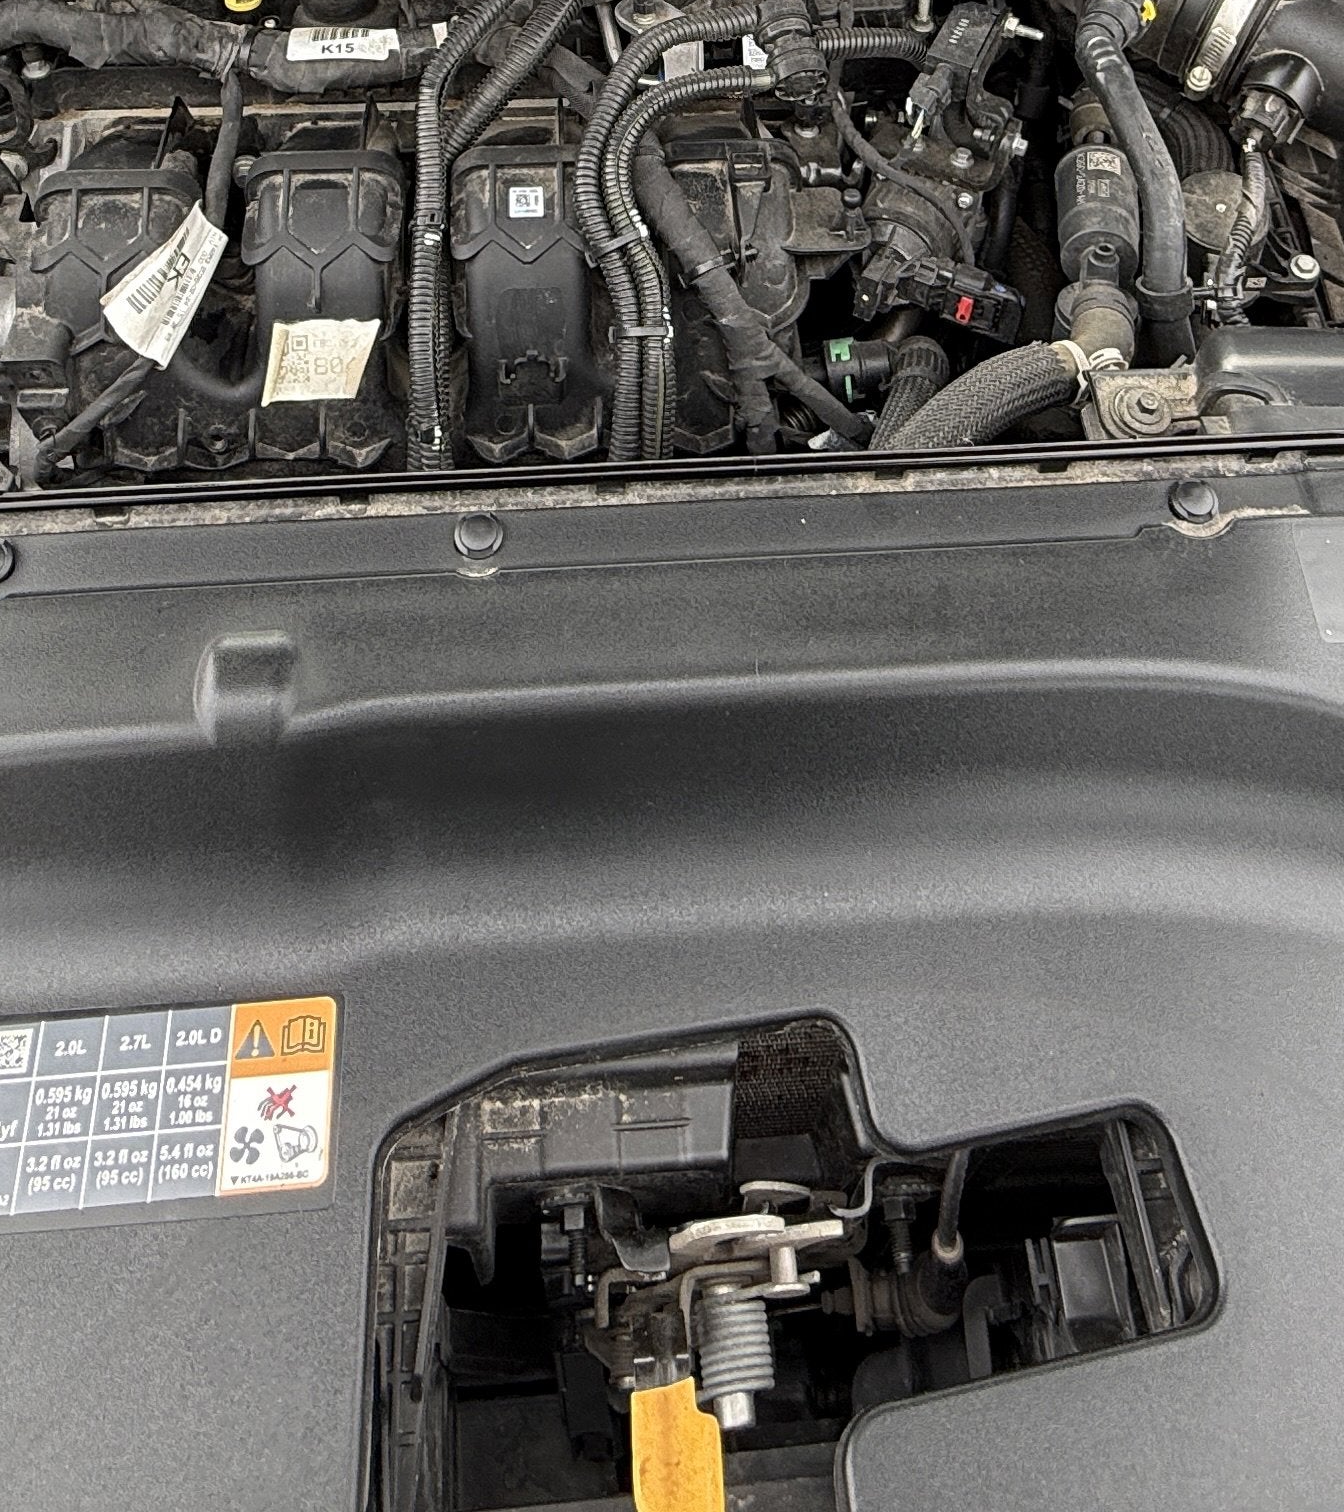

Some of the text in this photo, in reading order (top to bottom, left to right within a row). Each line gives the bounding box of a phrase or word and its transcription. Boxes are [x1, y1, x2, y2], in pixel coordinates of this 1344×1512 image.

[321, 43, 355, 54] K15
[119, 1034, 152, 1051] 2.7L
[175, 1027, 222, 1047] 2.0L D
[54, 1039, 88, 1057] 2.0L
[101, 1079, 157, 1100] 0.595 kg
[166, 1073, 222, 1094] 0.454 kg
[35, 1085, 92, 1105] 0.595 kg
[177, 1094, 208, 1108] 16 oz
[45, 1106, 77, 1120] 21 oz
[111, 1100, 144, 1115] 21 oz
[103, 1114, 148, 1131] 1.31 lbs
[169, 1110, 213, 1126] 1.00 lbs
[37, 1121, 81, 1137] 1.31 lbs
[94, 1149, 149, 1167] 3.2 fl oz
[159, 1143, 214, 1161] 5.4 fl oz
[26, 1154, 82, 1173] 3.2 fl oz
[158, 1161, 214, 1184] (160 cc)
[27, 1173, 76, 1196] (95 cc)
[96, 1167, 144, 1190] (95 cc)
